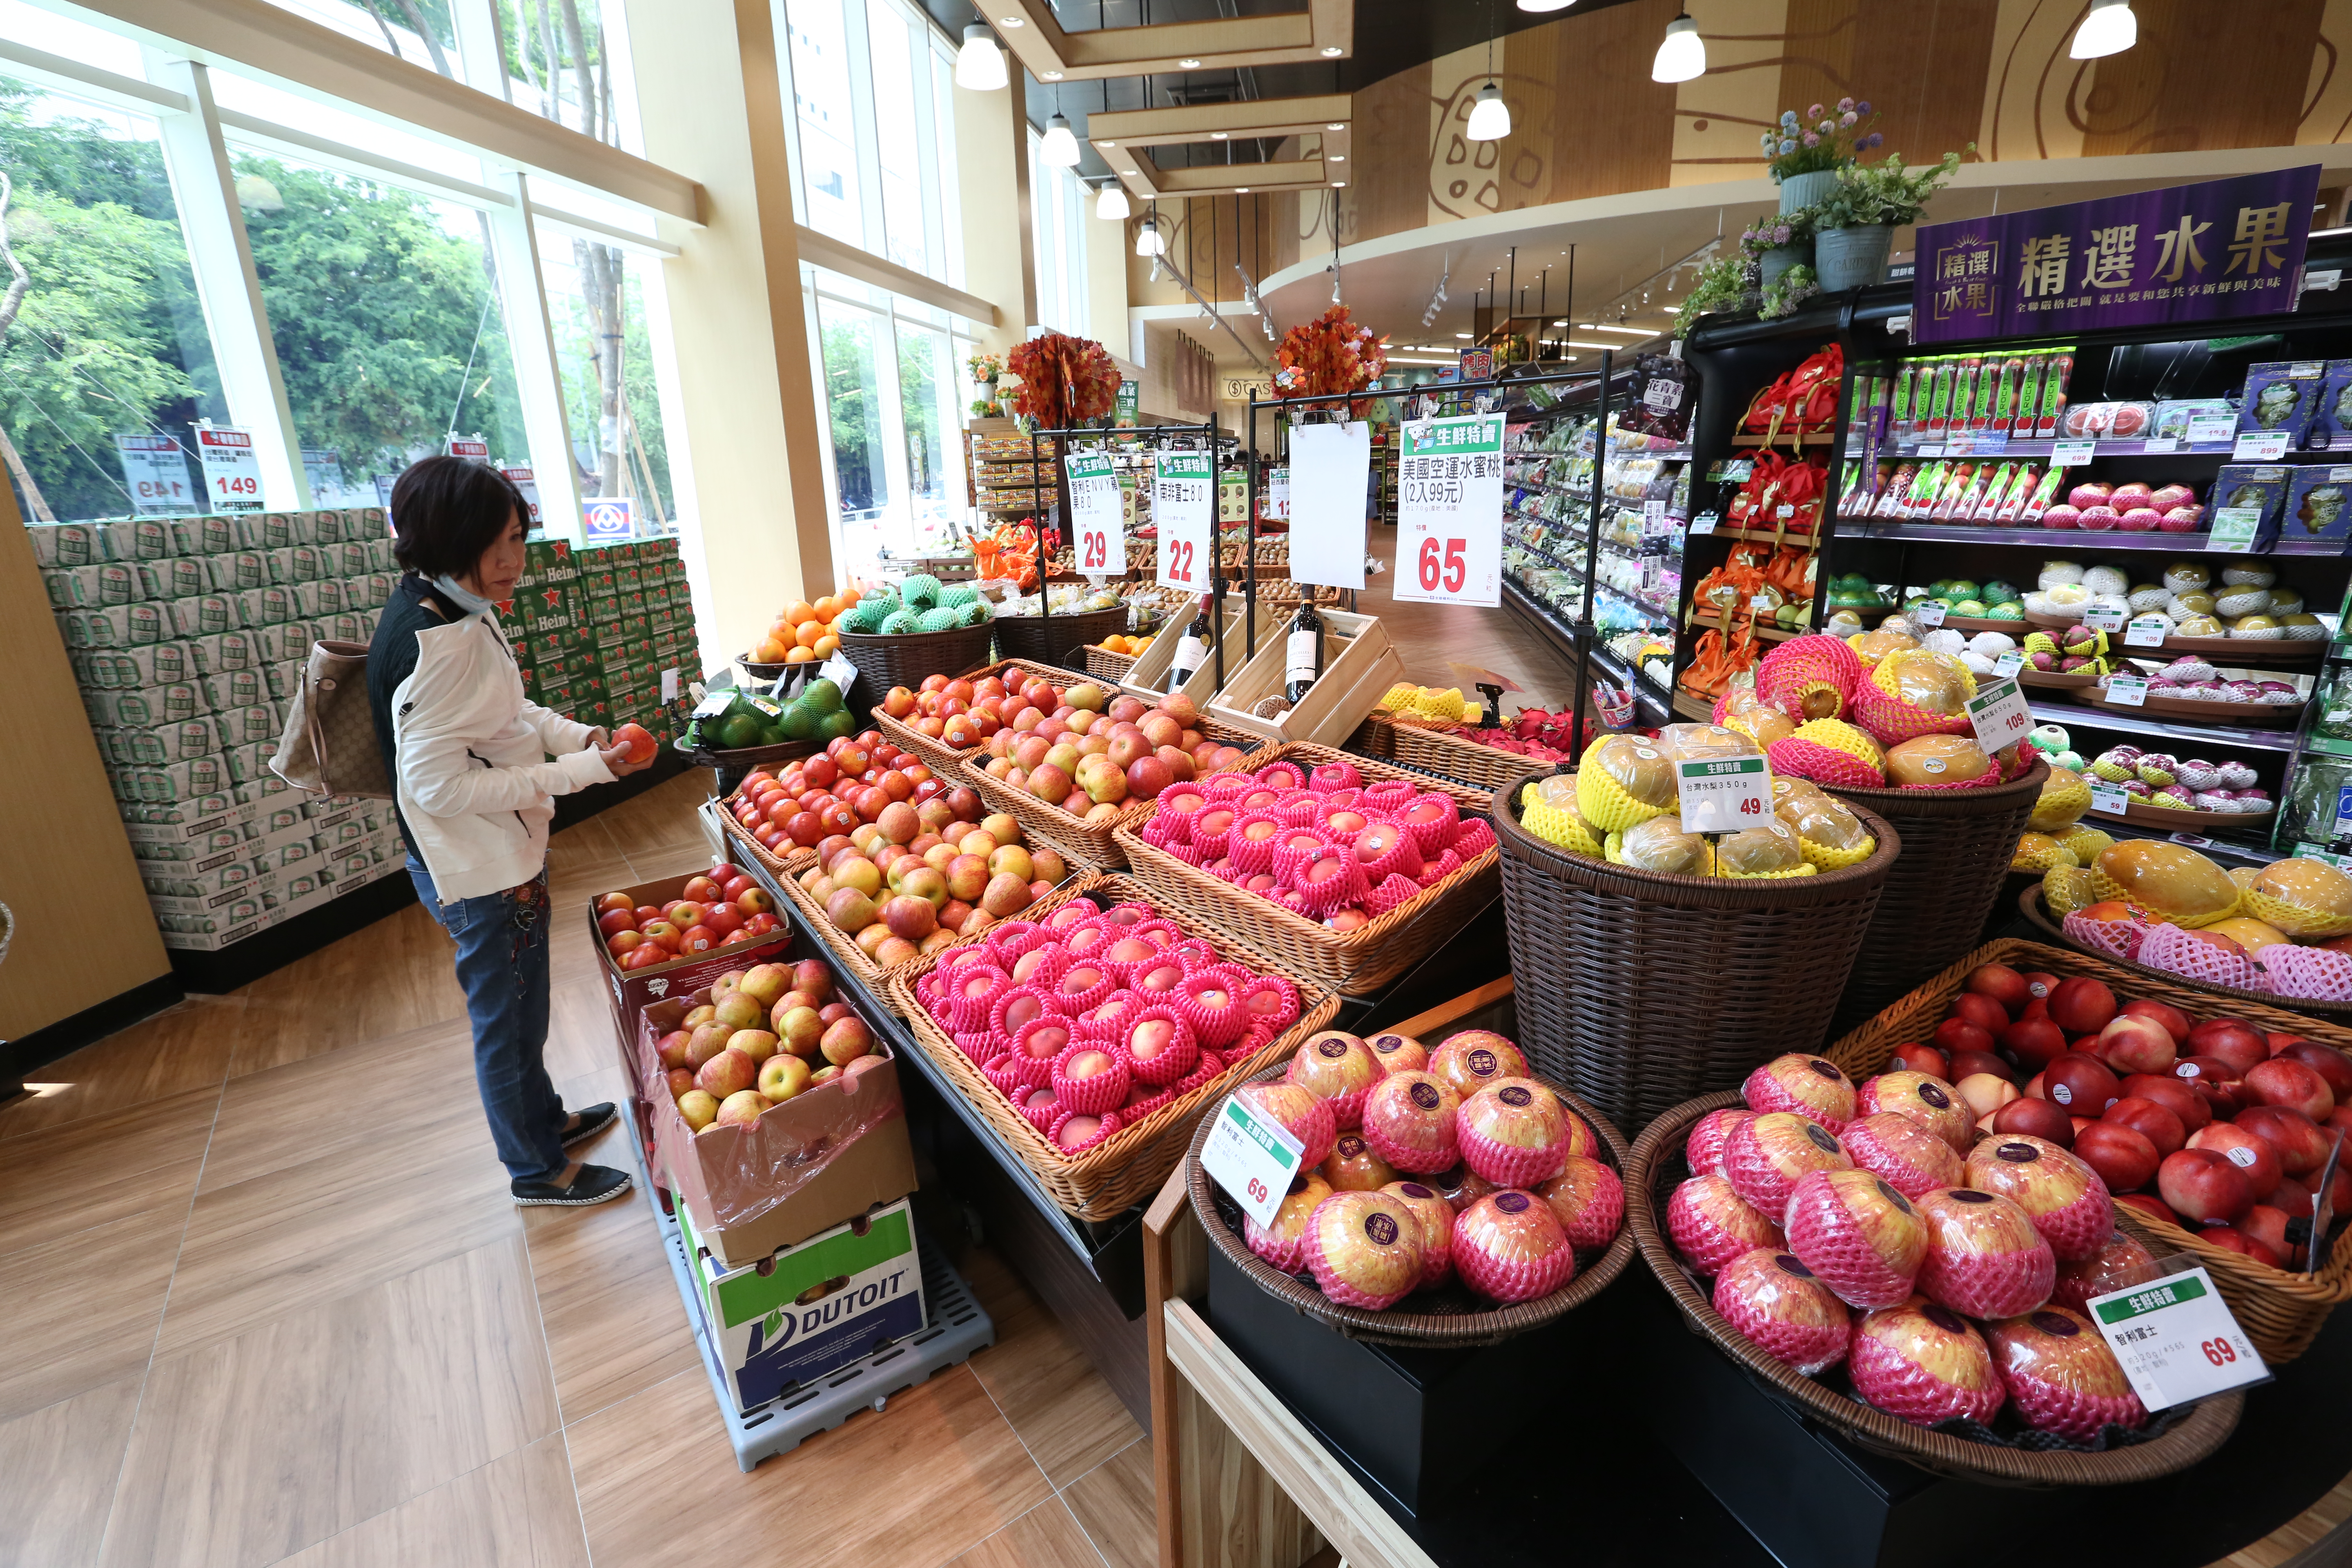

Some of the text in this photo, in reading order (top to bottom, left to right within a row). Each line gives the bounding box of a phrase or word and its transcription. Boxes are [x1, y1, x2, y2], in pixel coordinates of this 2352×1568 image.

[2017, 202, 2293, 297] 精選水果
[1944, 250, 1989, 278] 精選
[1942, 283, 1987, 312] 水果
[2016, 276, 2282, 313] 全聯嚴格把關 就是要和您共享新鮮與美味
[1461, 353, 1490, 369] 烤肉
[1118, 386, 1136, 396] 蔬菜
[1244, 383, 1270, 394] CAS
[1648, 379, 1684, 396] 花青素
[1898, 379, 1907, 411] ROCKIT
[1937, 377, 1947, 410] ROCKIT
[1956, 377, 1966, 411] ROCKIT
[1978, 375, 1987, 409] ROCKIT
[1999, 376, 2008, 410] ROCKIT
[2023, 374, 2033, 408] ROCKIT
[2046, 374, 2056, 408] ROCKIT
[1119, 398, 1136, 407] 三寶
[1649, 393, 1674, 407] 三寶
[1436, 424, 1497, 446] 生鮮特賣
[1082, 457, 1111, 472] 生鮮特賣
[1173, 458, 1209, 472] 生鮮特賣
[1403, 454, 1501, 481] 美國空運水蜜桃
[217, 477, 256, 494] 149
[1071, 476, 1118, 495] 智利ENVY蘋
[1160, 482, 1203, 503] 南非富士80
[1405, 480, 1463, 504] (2入99元)
[1073, 496, 1091, 510] 果80
[1084, 531, 1106, 568] 29
[1168, 539, 1193, 583] 22
[1419, 537, 1466, 593] 65
[1983, 689, 2005, 706] 生鮮特賣
[1977, 702, 2011, 724] 台灣水梨650g
[2006, 713, 2025, 731] 109
[1707, 762, 1742, 774] 生鮮特賣
[1686, 781, 1747, 792] 台灣水梨350g
[1740, 797, 1761, 815] 49
[710, 965, 735, 974] EXPORTADORA
[1221, 1121, 1245, 1147] 智利富士
[1245, 1119, 1276, 1152] 生鮮特賣
[1247, 1177, 1268, 1204] 69
[802, 1270, 905, 1334] DUTOIT
[2128, 1286, 2177, 1314] 生鮮特賣
[2115, 1324, 2158, 1347] 智利富士
[2201, 1336, 2236, 1367] 69
